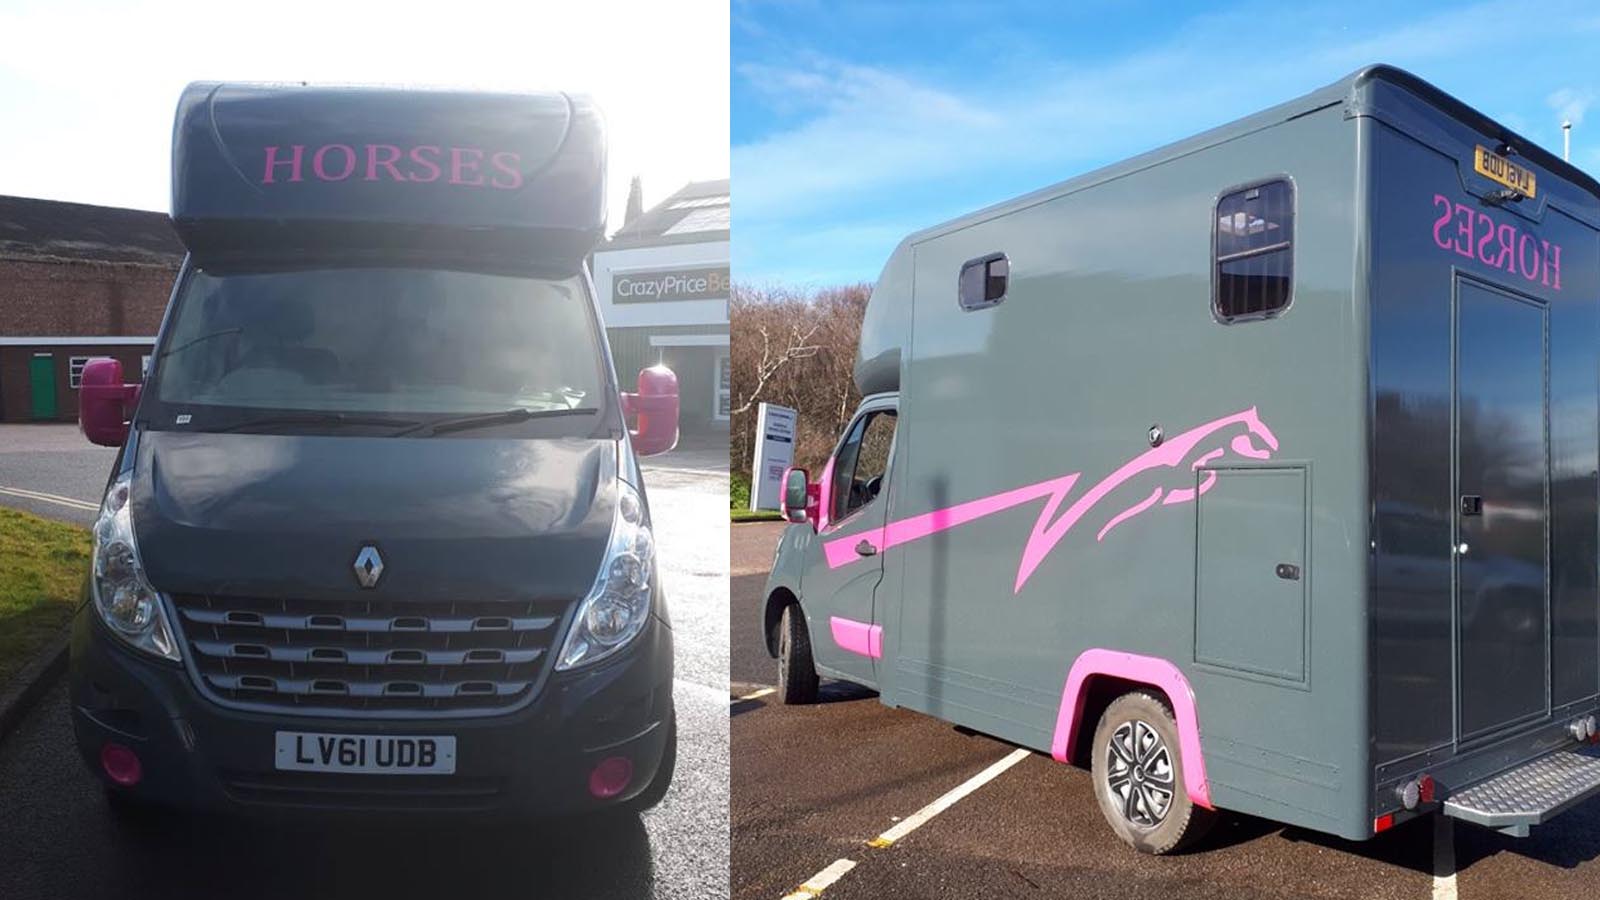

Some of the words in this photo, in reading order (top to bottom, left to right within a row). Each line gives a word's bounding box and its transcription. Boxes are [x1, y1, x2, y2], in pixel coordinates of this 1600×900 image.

[262, 143, 524, 189] HORSES
[296, 735, 366, 766] LV61
[375, 739, 437, 768] UDB
